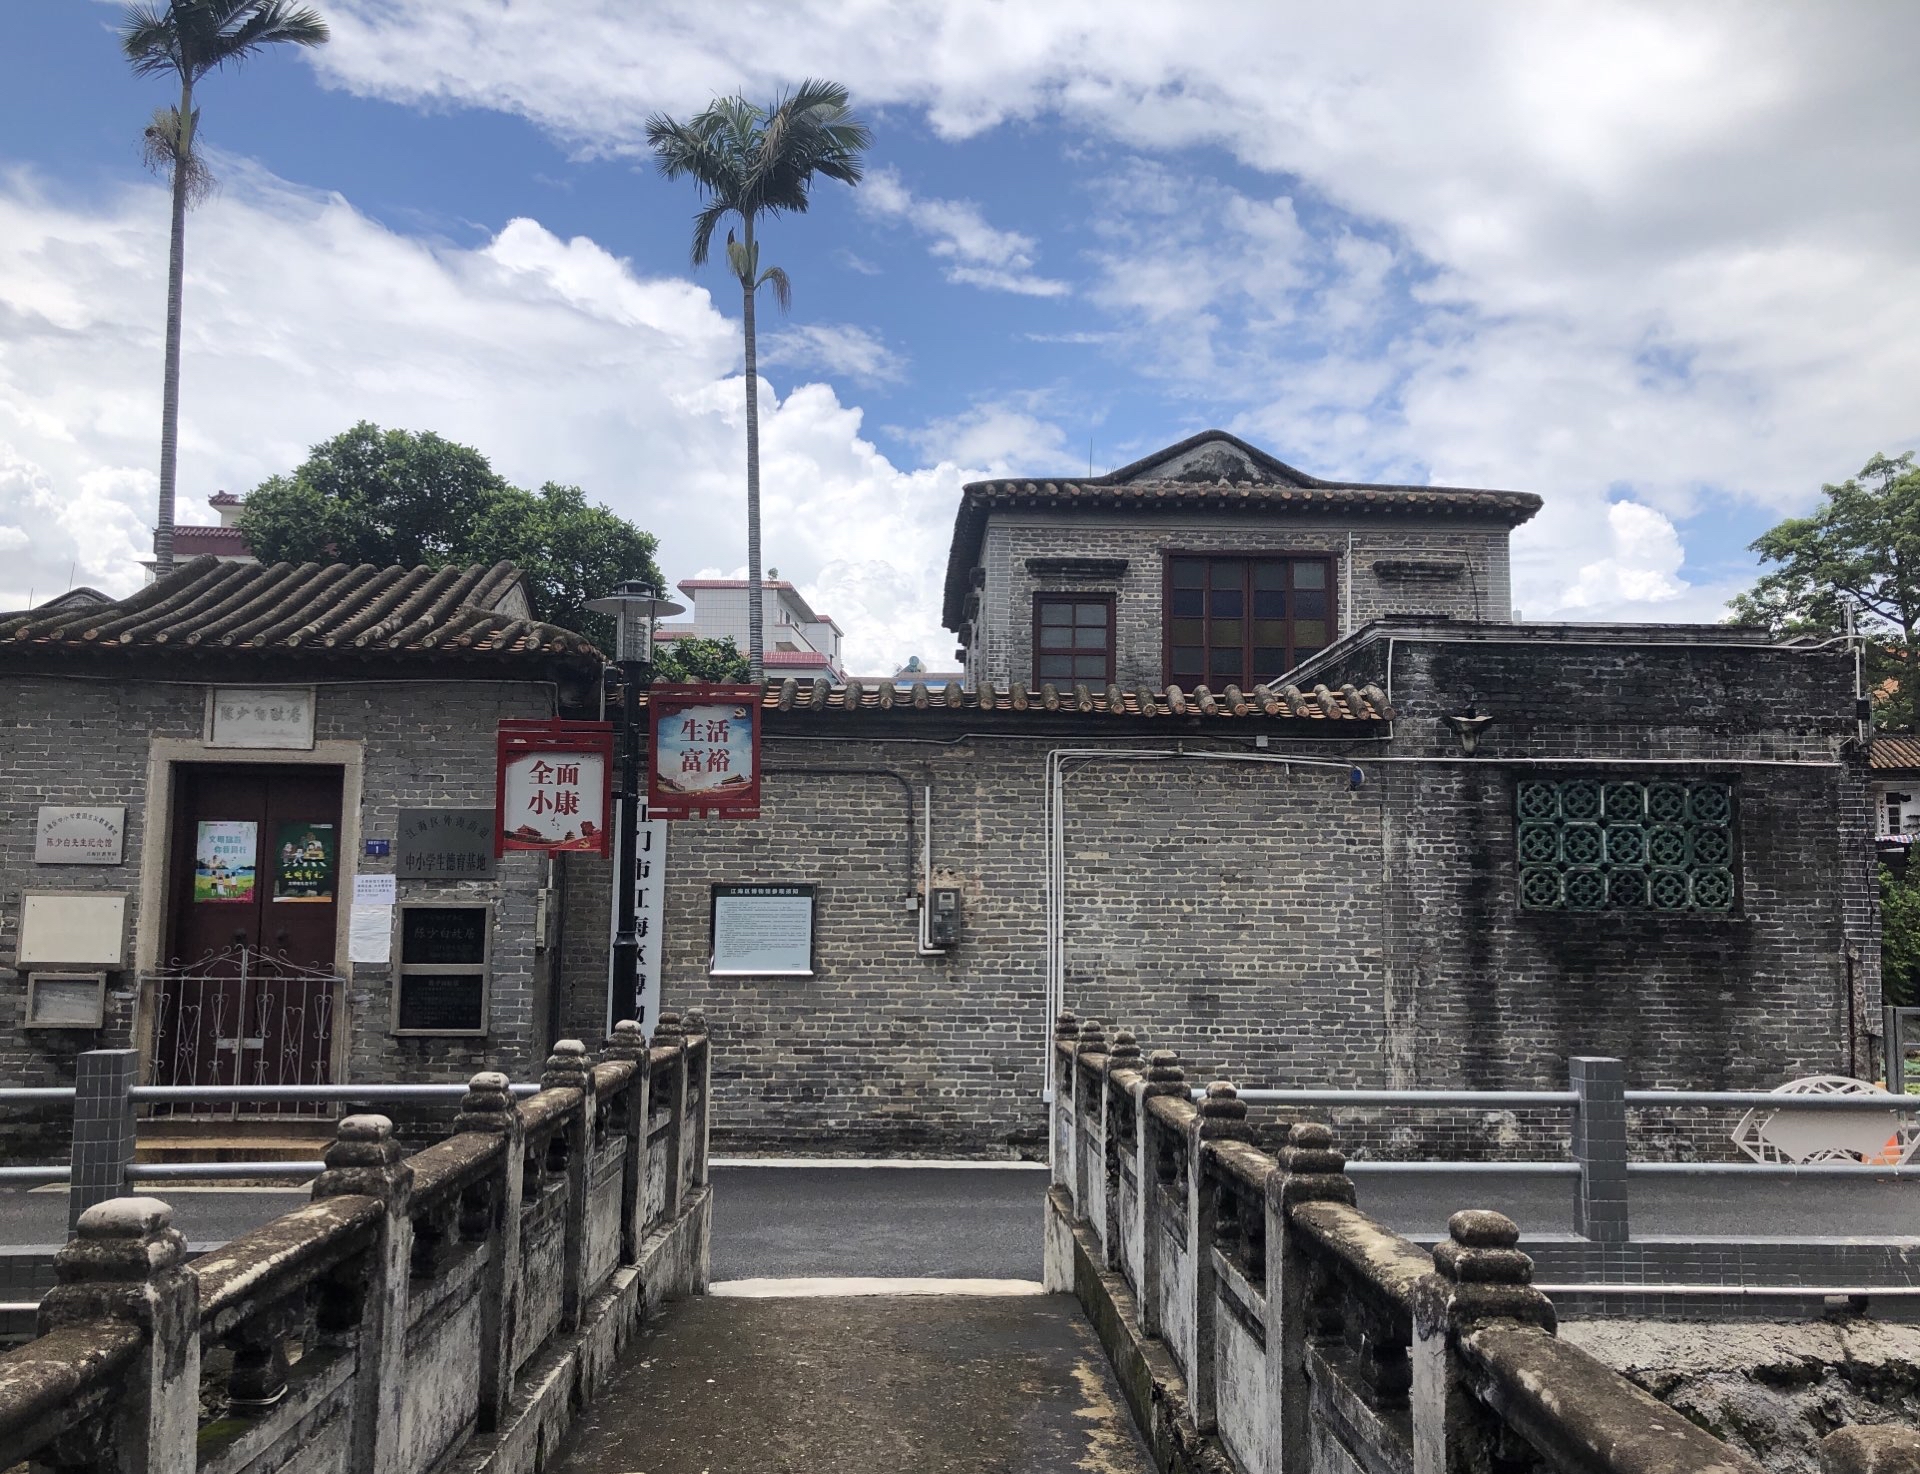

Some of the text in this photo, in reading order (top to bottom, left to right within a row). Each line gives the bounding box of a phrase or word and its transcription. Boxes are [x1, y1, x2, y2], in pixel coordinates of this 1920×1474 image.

[680, 719, 730, 743] 生活
[680, 748, 730, 773] 富裕
[529, 760, 581, 786] 全面
[527, 790, 580, 816] 小康
[46, 837, 113, 848] 陈少白先生纪念馆
[406, 852, 487, 871] 中小学生德育基地
